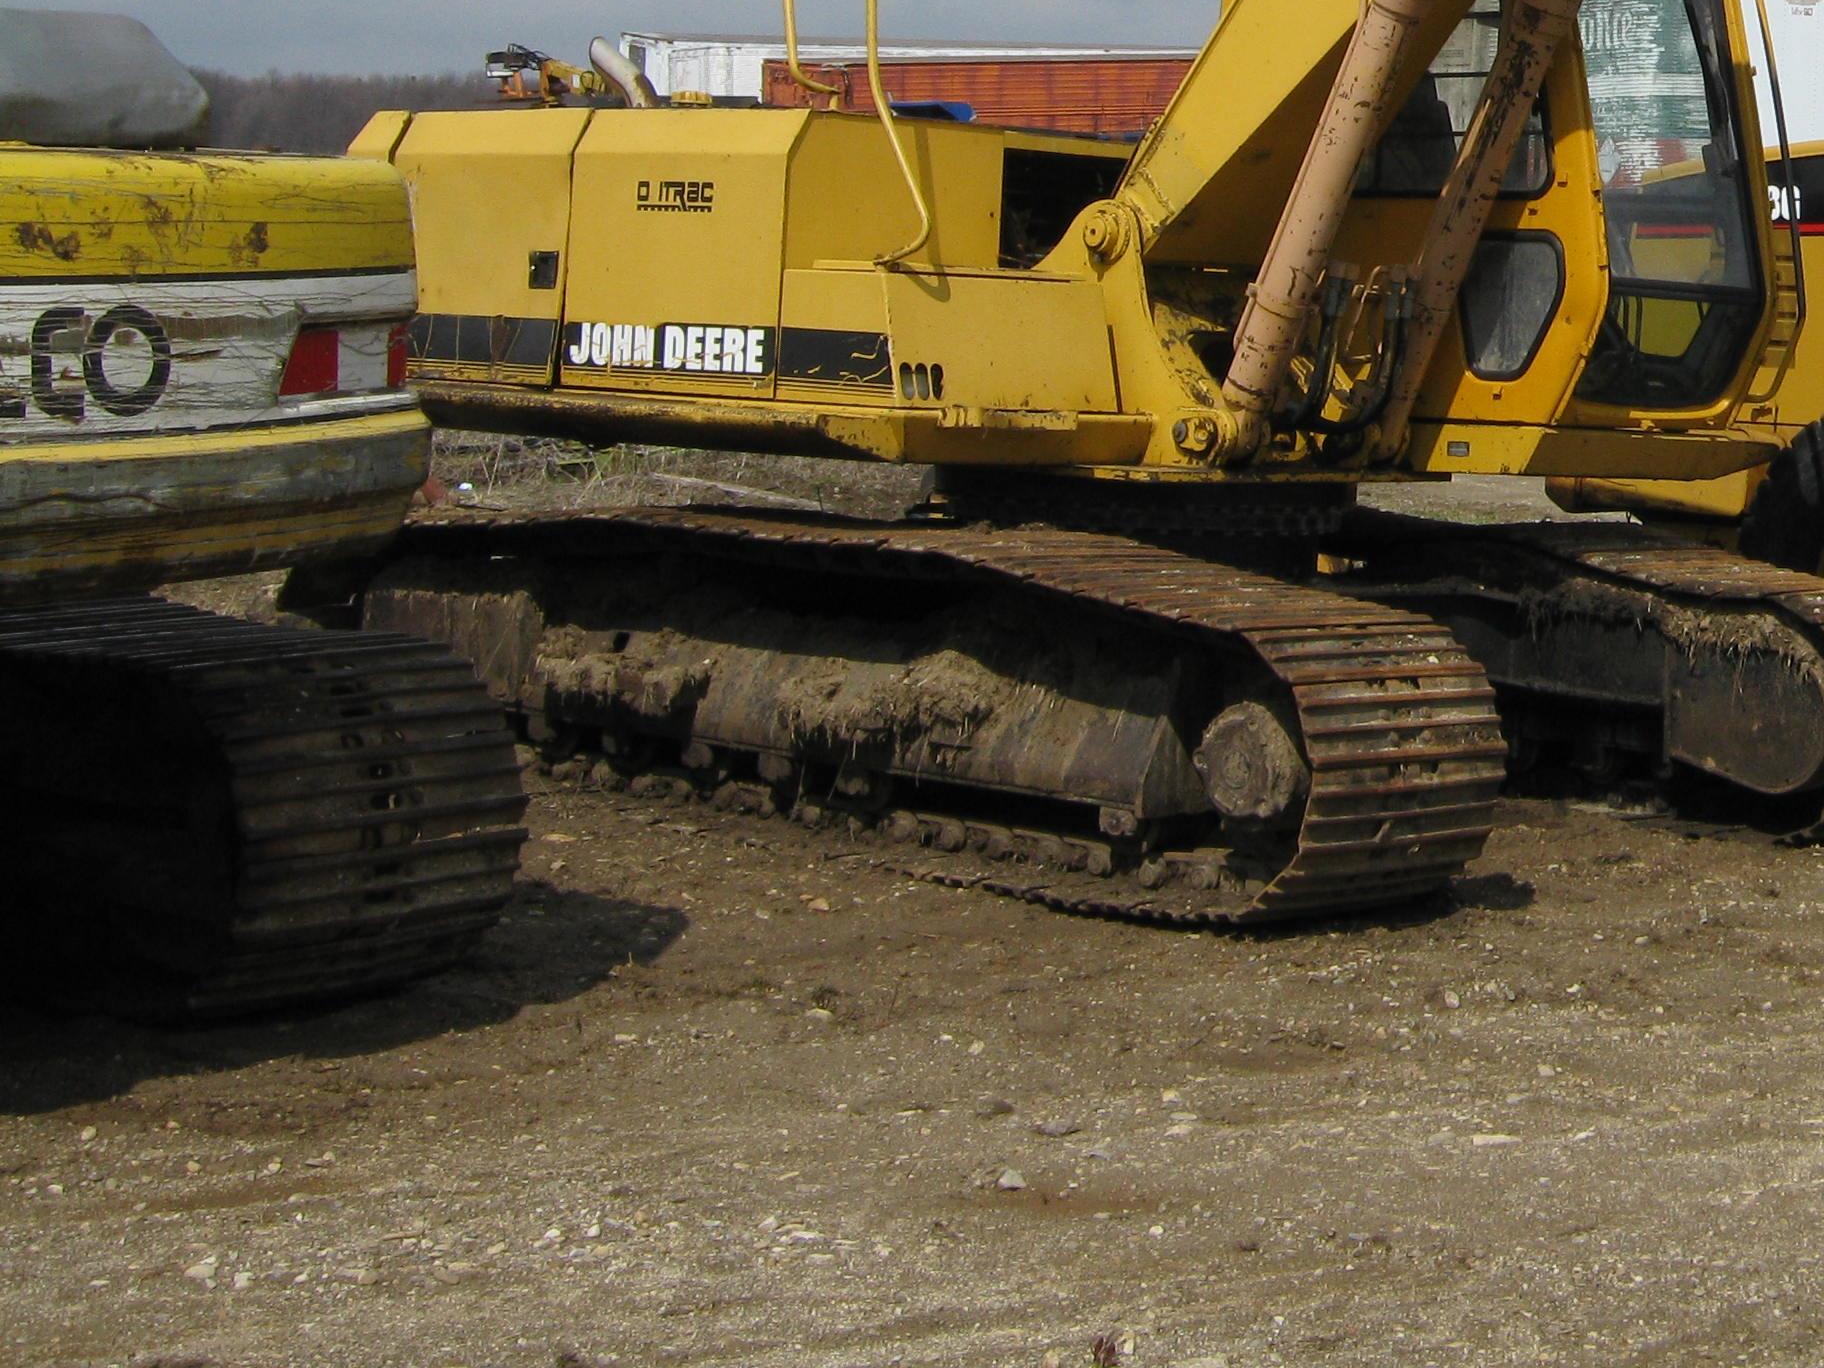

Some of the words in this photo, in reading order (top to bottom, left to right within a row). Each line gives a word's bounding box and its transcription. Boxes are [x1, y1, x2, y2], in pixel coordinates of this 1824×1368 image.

[0, 304, 171, 418] CO
[569, 321, 655, 368] JOHN
[664, 325, 765, 374] DEERE
